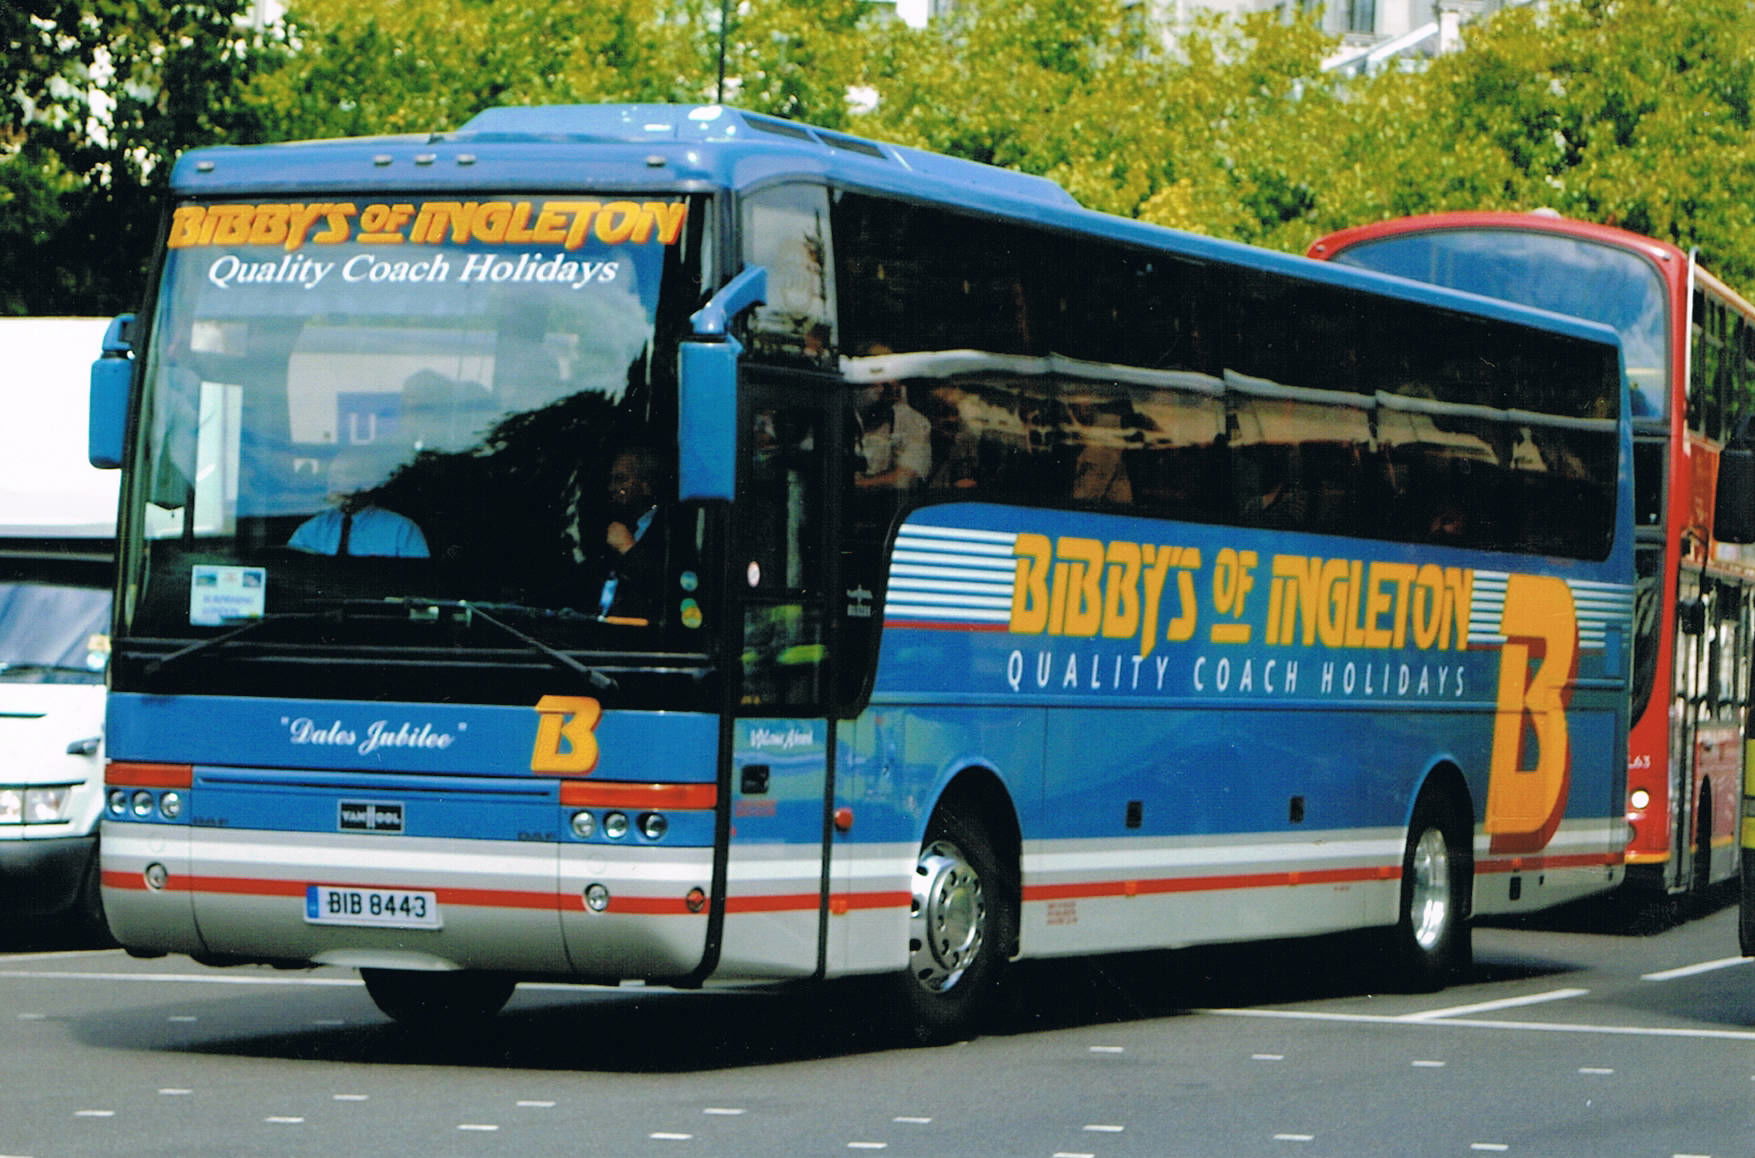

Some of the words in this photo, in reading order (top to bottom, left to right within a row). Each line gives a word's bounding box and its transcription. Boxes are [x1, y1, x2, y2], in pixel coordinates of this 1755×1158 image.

[167, 202, 357, 251] BIBBY'S
[357, 203, 416, 244] OF
[409, 201, 687, 250] INGLETON
[208, 254, 336, 289] Quality
[342, 253, 450, 283] Coach
[459, 252, 619, 290] Holidays
[1009, 532, 1201, 659] BIBBY'S
[1211, 547, 1258, 643] OF
[1265, 553, 1474, 650] INGLETON
[1007, 649, 1168, 692] QUALITY
[1193, 656, 1298, 692] COACH
[1321, 661, 1464, 697] HOLIDAYS
[530, 695, 603, 776] B
[1484, 573, 1579, 855] B
[328, 891, 362, 914] BIB
[369, 894, 427, 918] 8443
